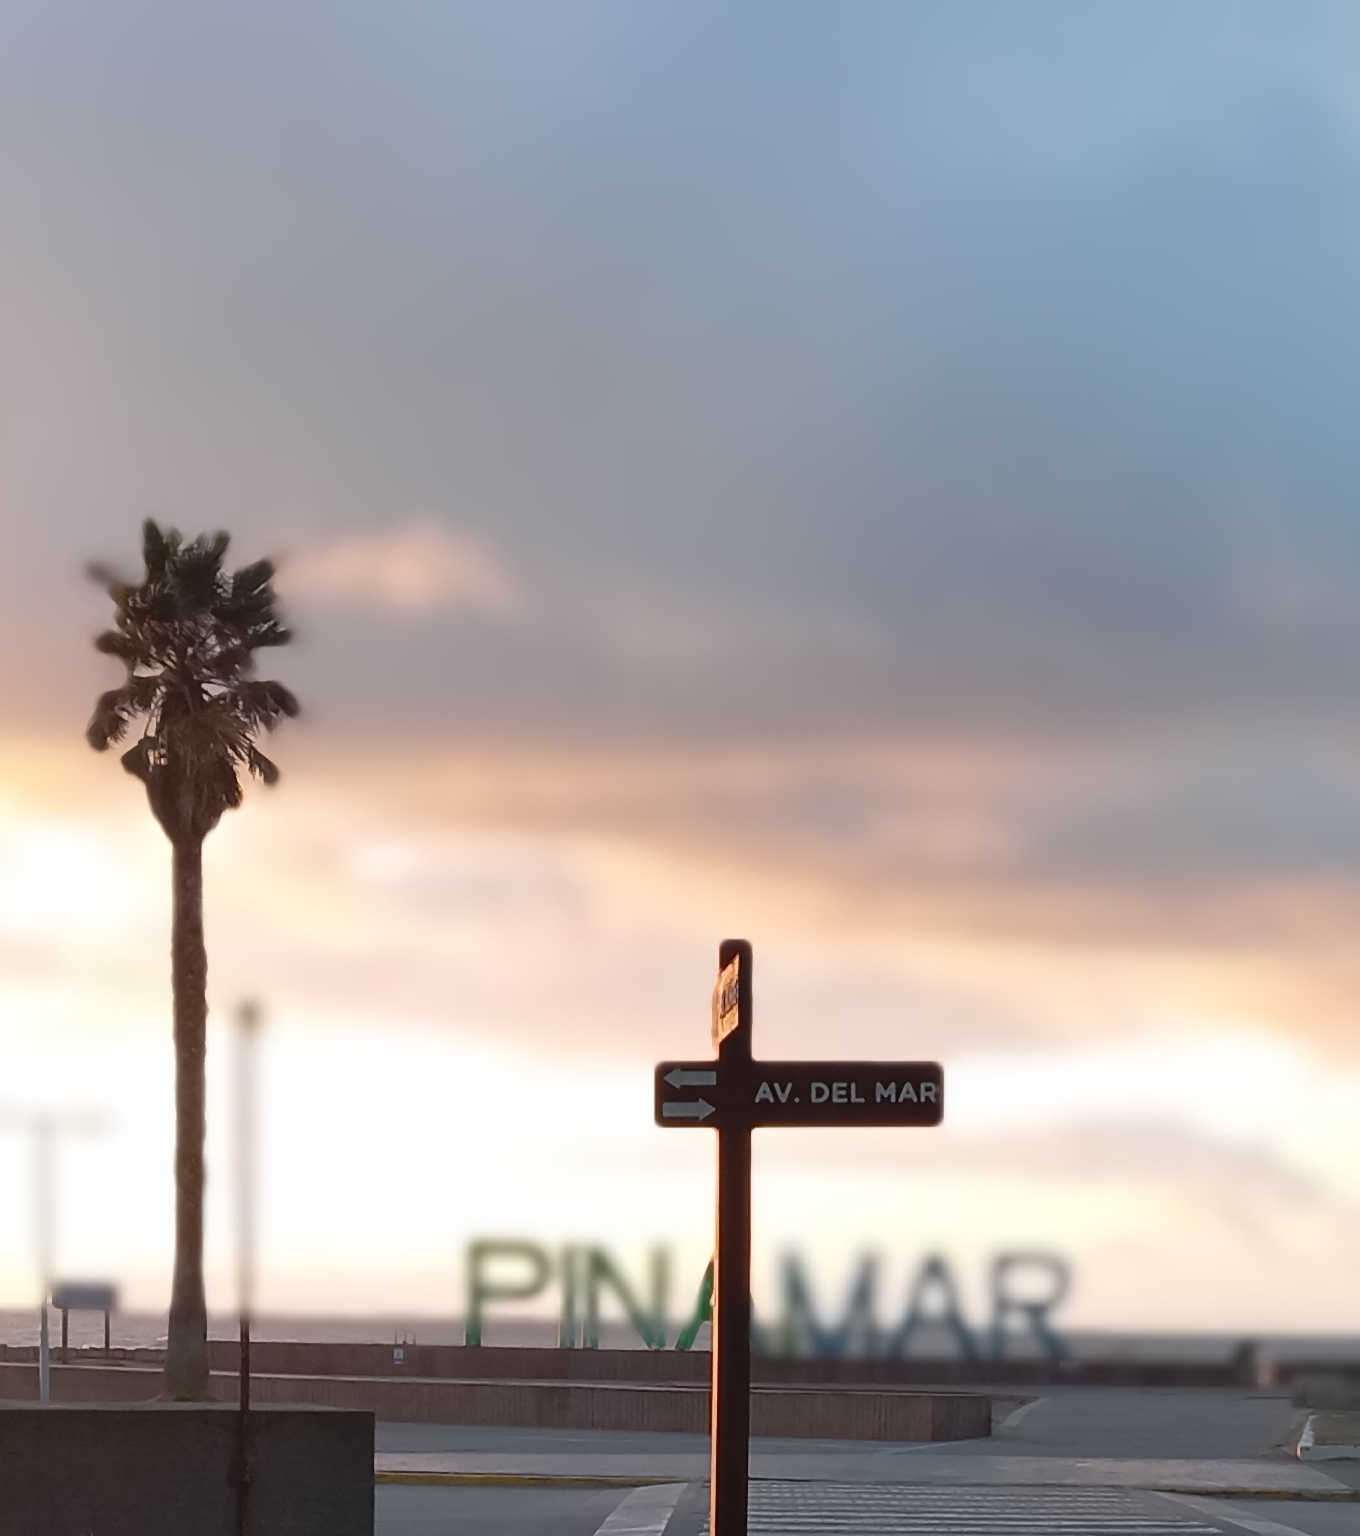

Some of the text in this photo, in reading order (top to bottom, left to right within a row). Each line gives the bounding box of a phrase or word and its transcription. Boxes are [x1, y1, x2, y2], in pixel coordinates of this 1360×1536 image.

[754, 1081, 937, 1104] AV. DEL MAR
